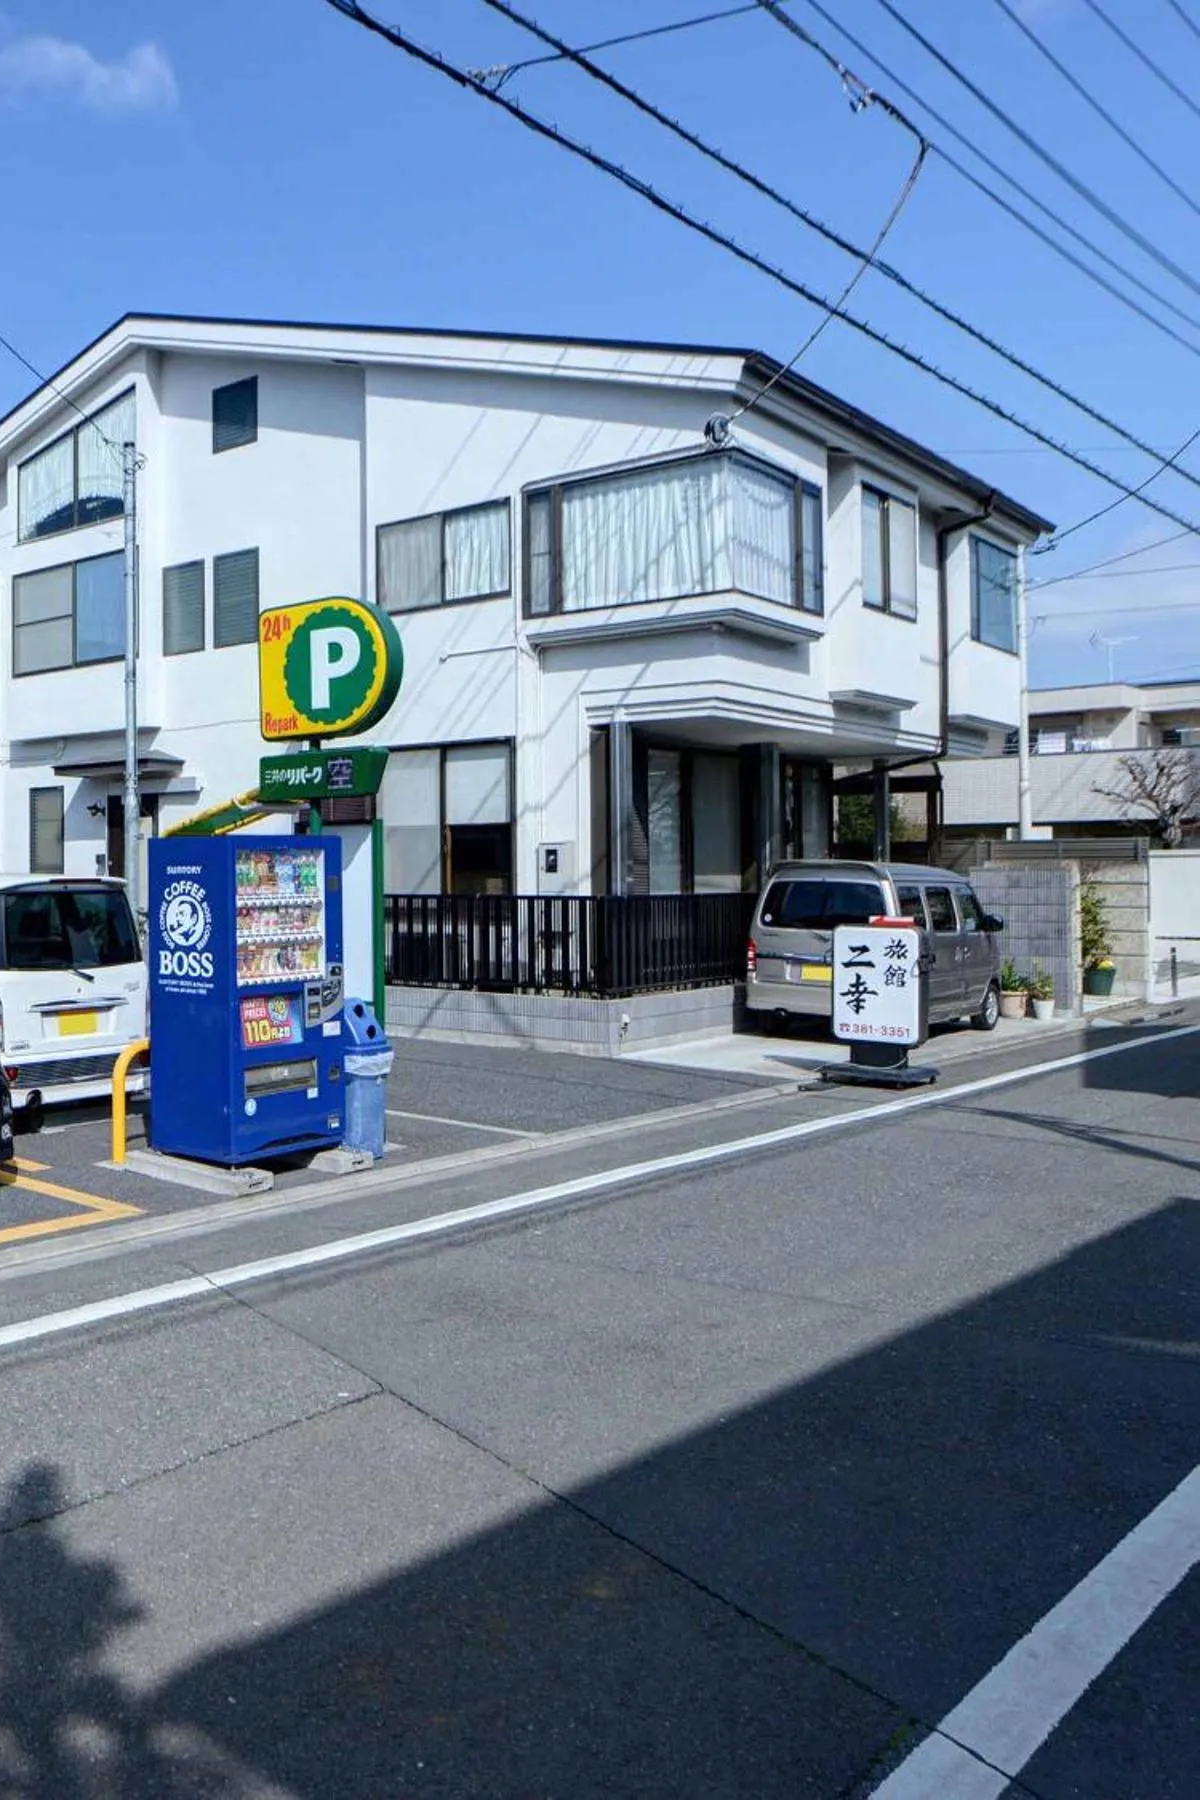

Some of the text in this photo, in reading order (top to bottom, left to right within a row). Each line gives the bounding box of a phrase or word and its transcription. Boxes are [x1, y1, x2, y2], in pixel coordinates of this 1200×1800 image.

[263, 614, 291, 643] 24h
[309, 626, 361, 710] P
[264, 712, 299, 736] Repark
[265, 765, 322, 786] 三井のリパーク
[164, 881, 206, 902] COFFEE
[159, 950, 214, 978] BOSS
[883, 937, 909, 988] 旅館
[852, 1023, 910, 1038] 381-3351
